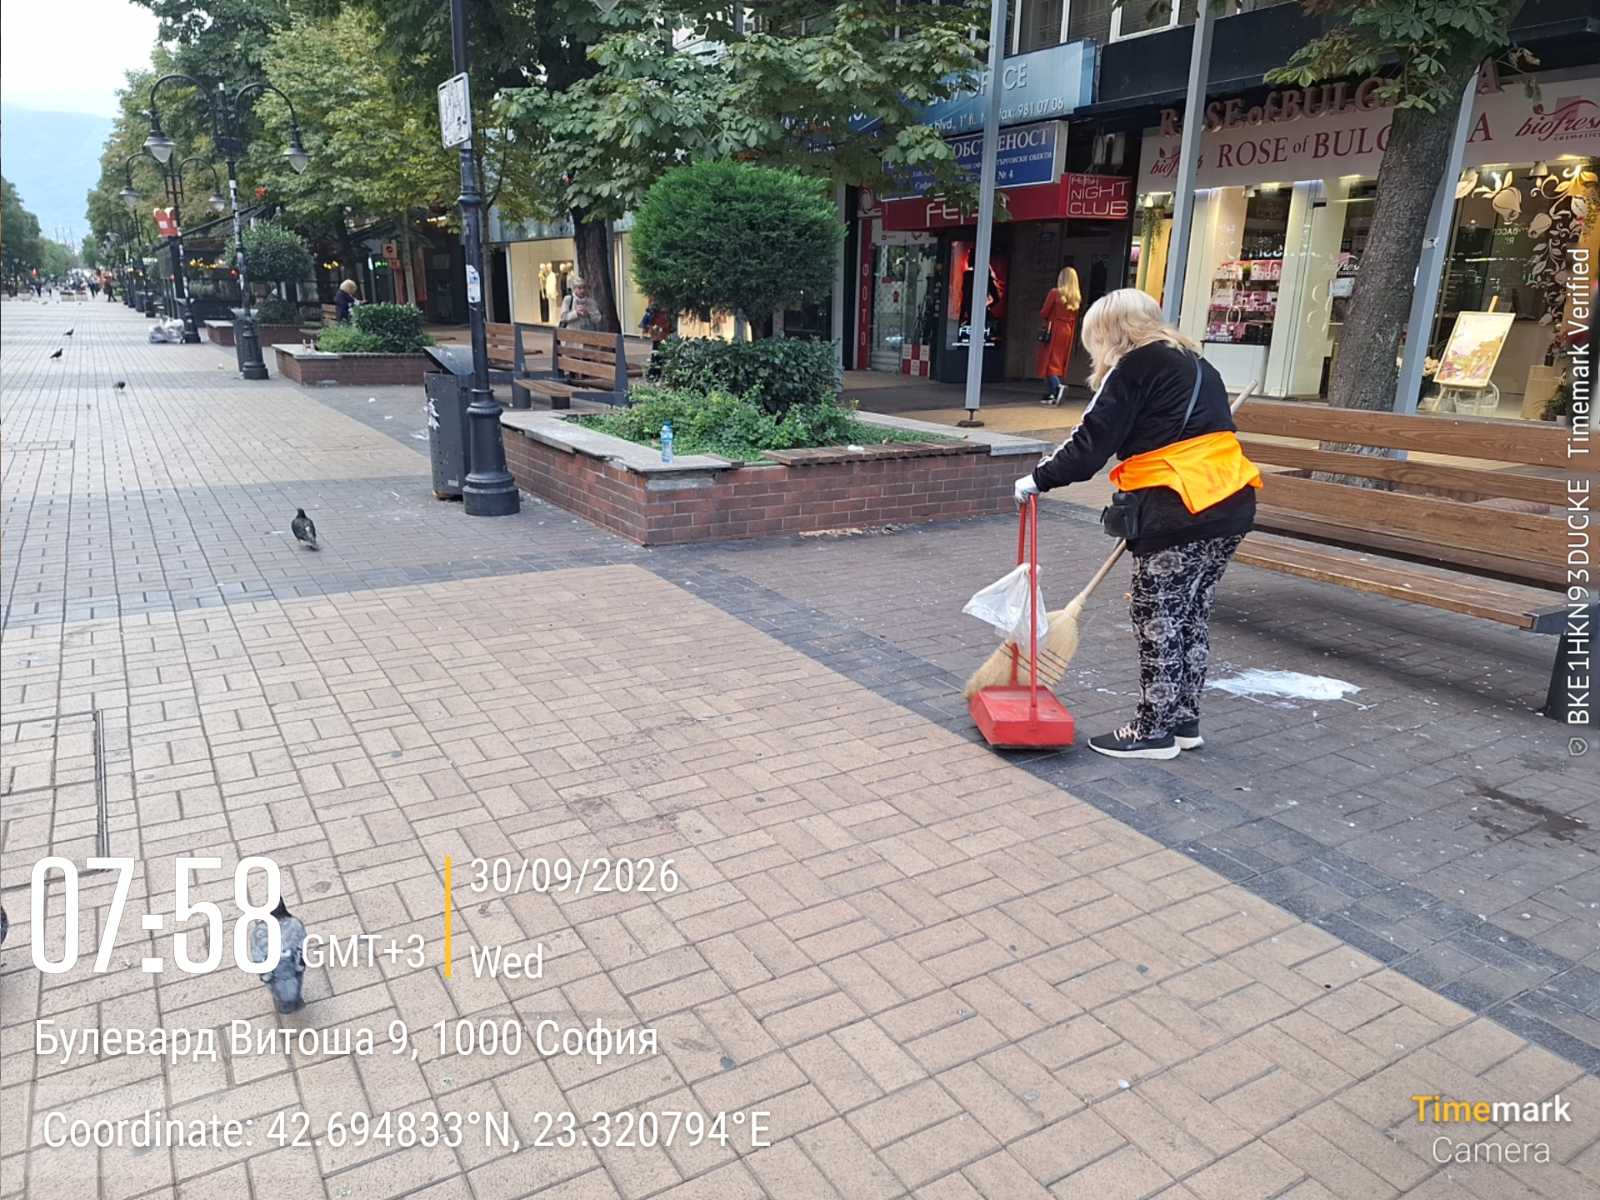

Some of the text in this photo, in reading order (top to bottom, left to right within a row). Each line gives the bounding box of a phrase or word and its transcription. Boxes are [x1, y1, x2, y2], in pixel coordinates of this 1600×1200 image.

[1160, 98, 1242, 136] RSE
[1217, 137, 1288, 168] ROSE
[1293, 135, 1310, 153] of
[1071, 181, 1128, 200] NIGHT
[1069, 201, 1129, 216] CLUB
